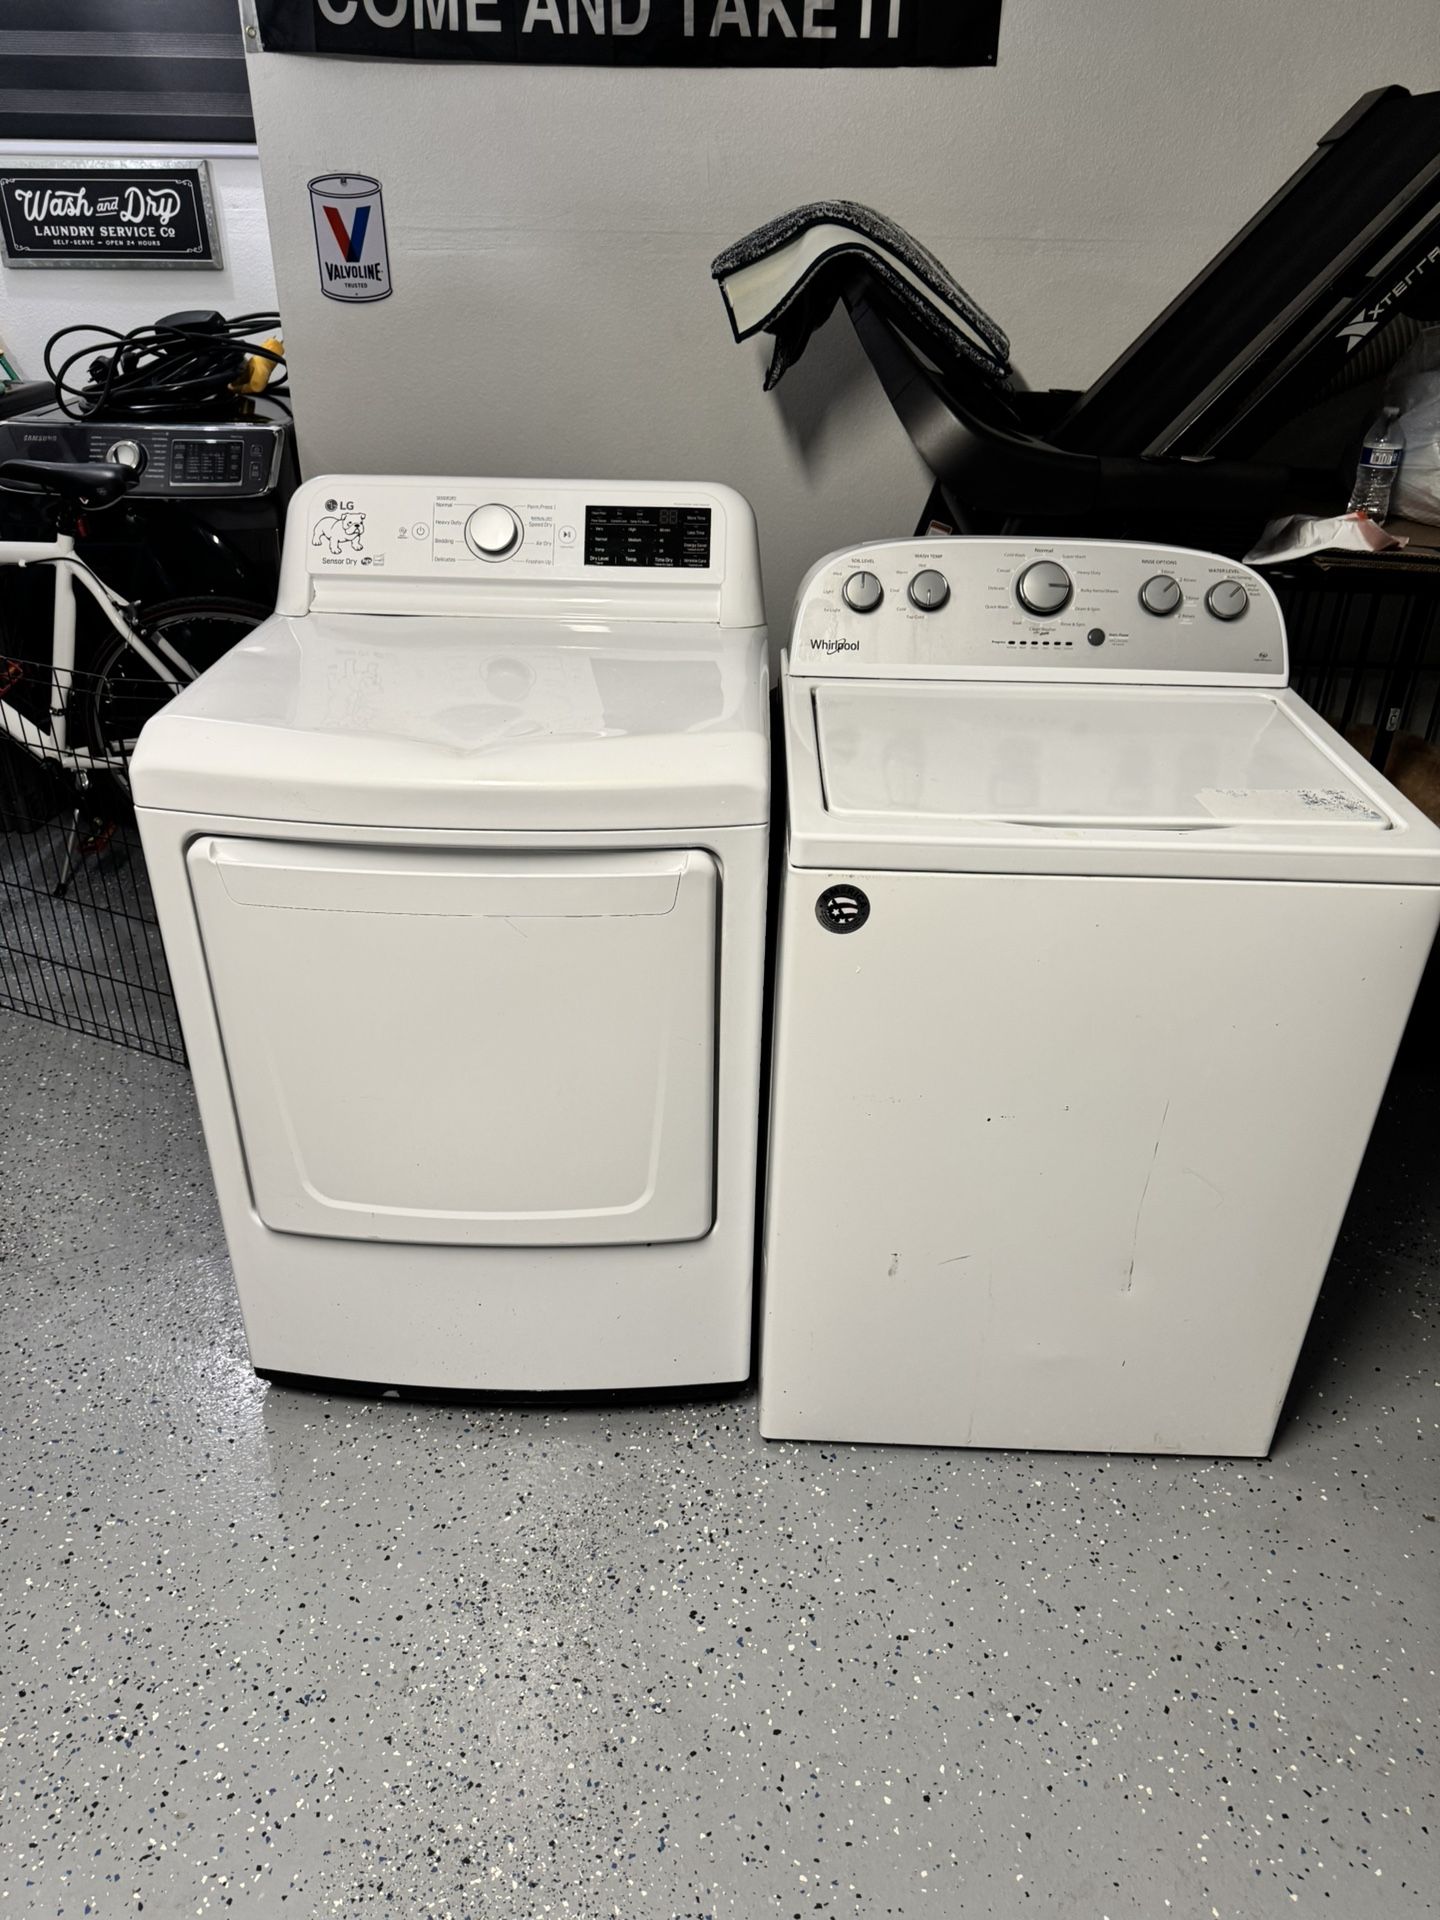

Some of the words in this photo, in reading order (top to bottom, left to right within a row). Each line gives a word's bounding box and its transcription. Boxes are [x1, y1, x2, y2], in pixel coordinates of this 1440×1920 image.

[14, 187, 94, 221] Wash
[96, 198, 119, 214] and
[120, 187, 181, 225] Dry
[34, 225, 95, 237] LAUNDRY
[100, 226, 156, 238] SERVICE
[325, 261, 382, 281] VALVOLINE
[340, 501, 355, 511] LG
[322, 557, 344, 565] Sensor
[346, 557, 358, 566] Dry
[810, 638, 860, 655] Whirlpool
